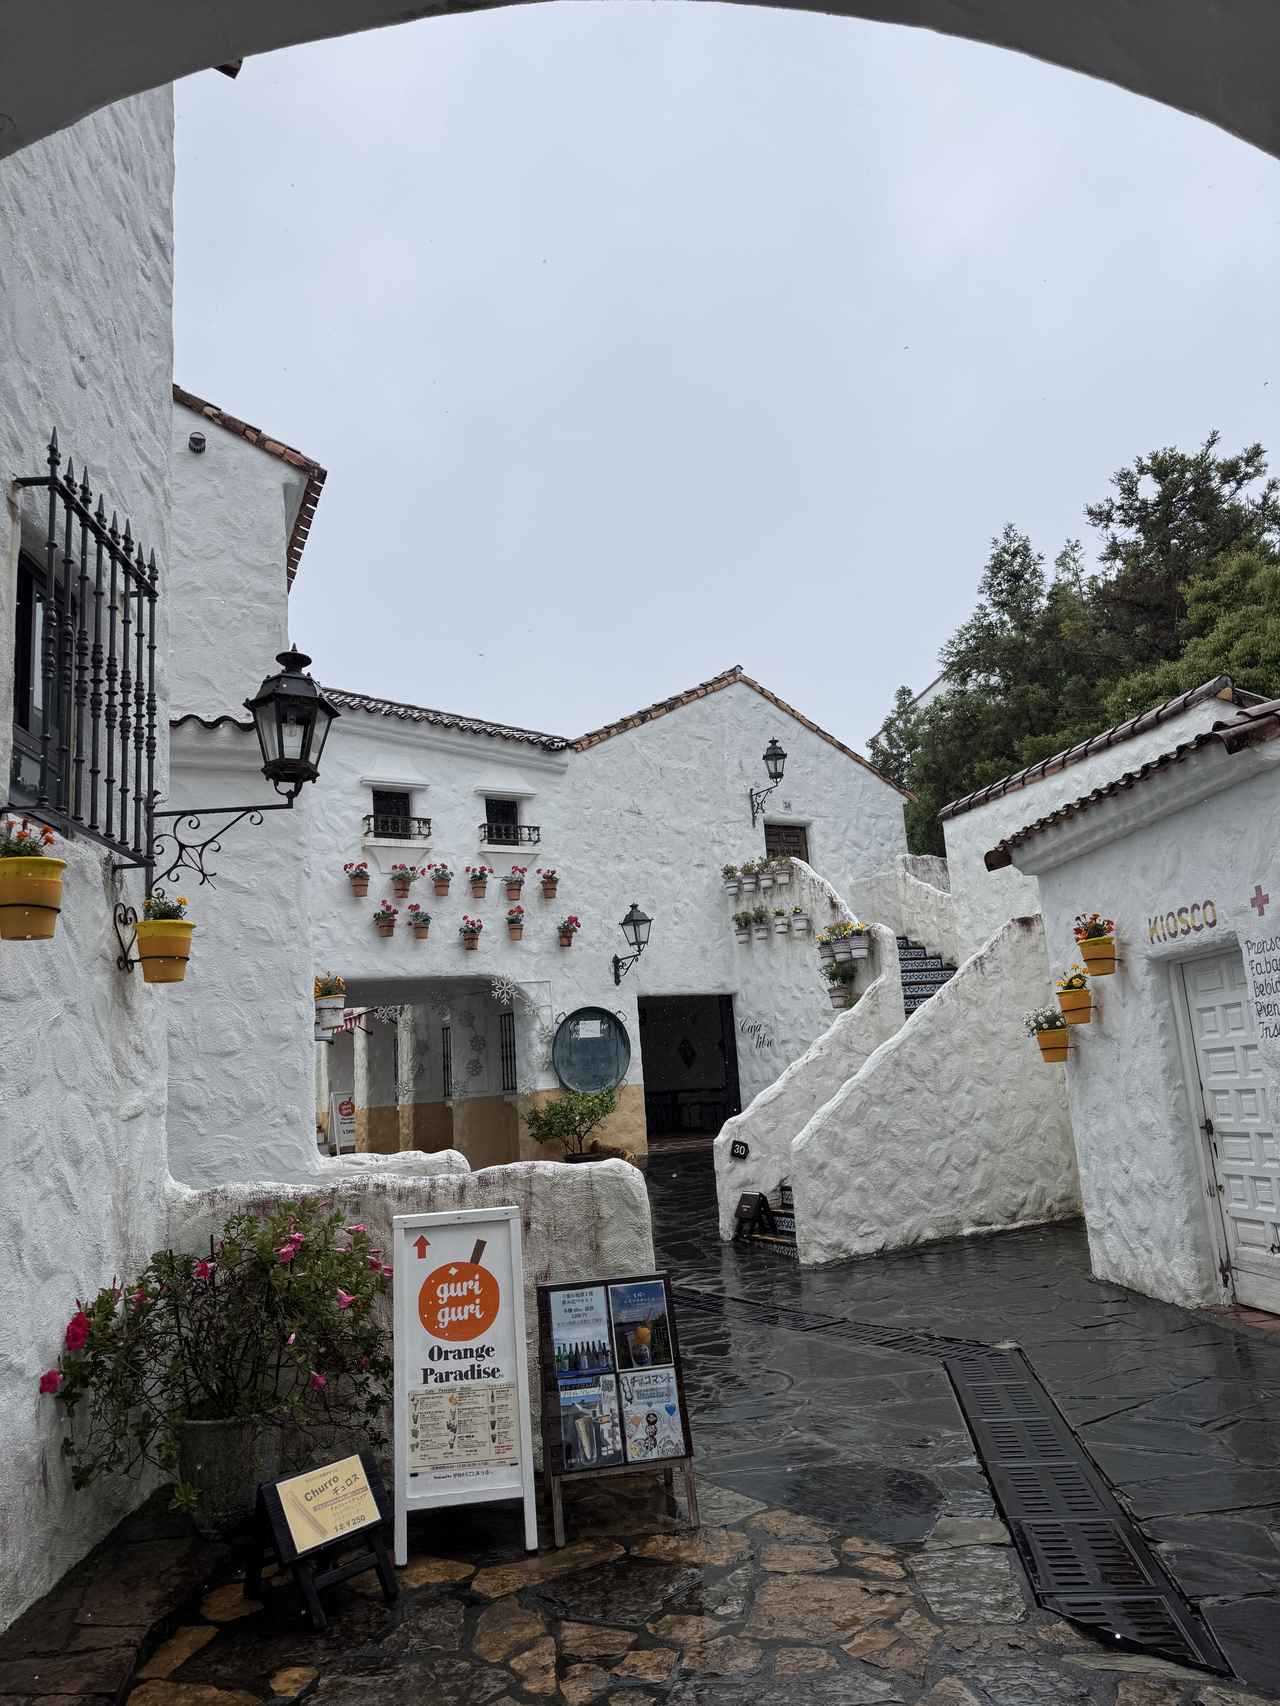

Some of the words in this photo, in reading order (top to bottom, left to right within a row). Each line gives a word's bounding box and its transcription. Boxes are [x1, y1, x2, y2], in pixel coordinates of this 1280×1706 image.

[1147, 900, 1217, 944] KIOSCO
[733, 1144, 746, 1156] 30
[436, 1273, 483, 1305] guri
[437, 1298, 485, 1329] guri
[428, 1344, 497, 1363] Orange
[421, 1363, 501, 1385] Paradise
[304, 1475, 340, 1502] Churro
